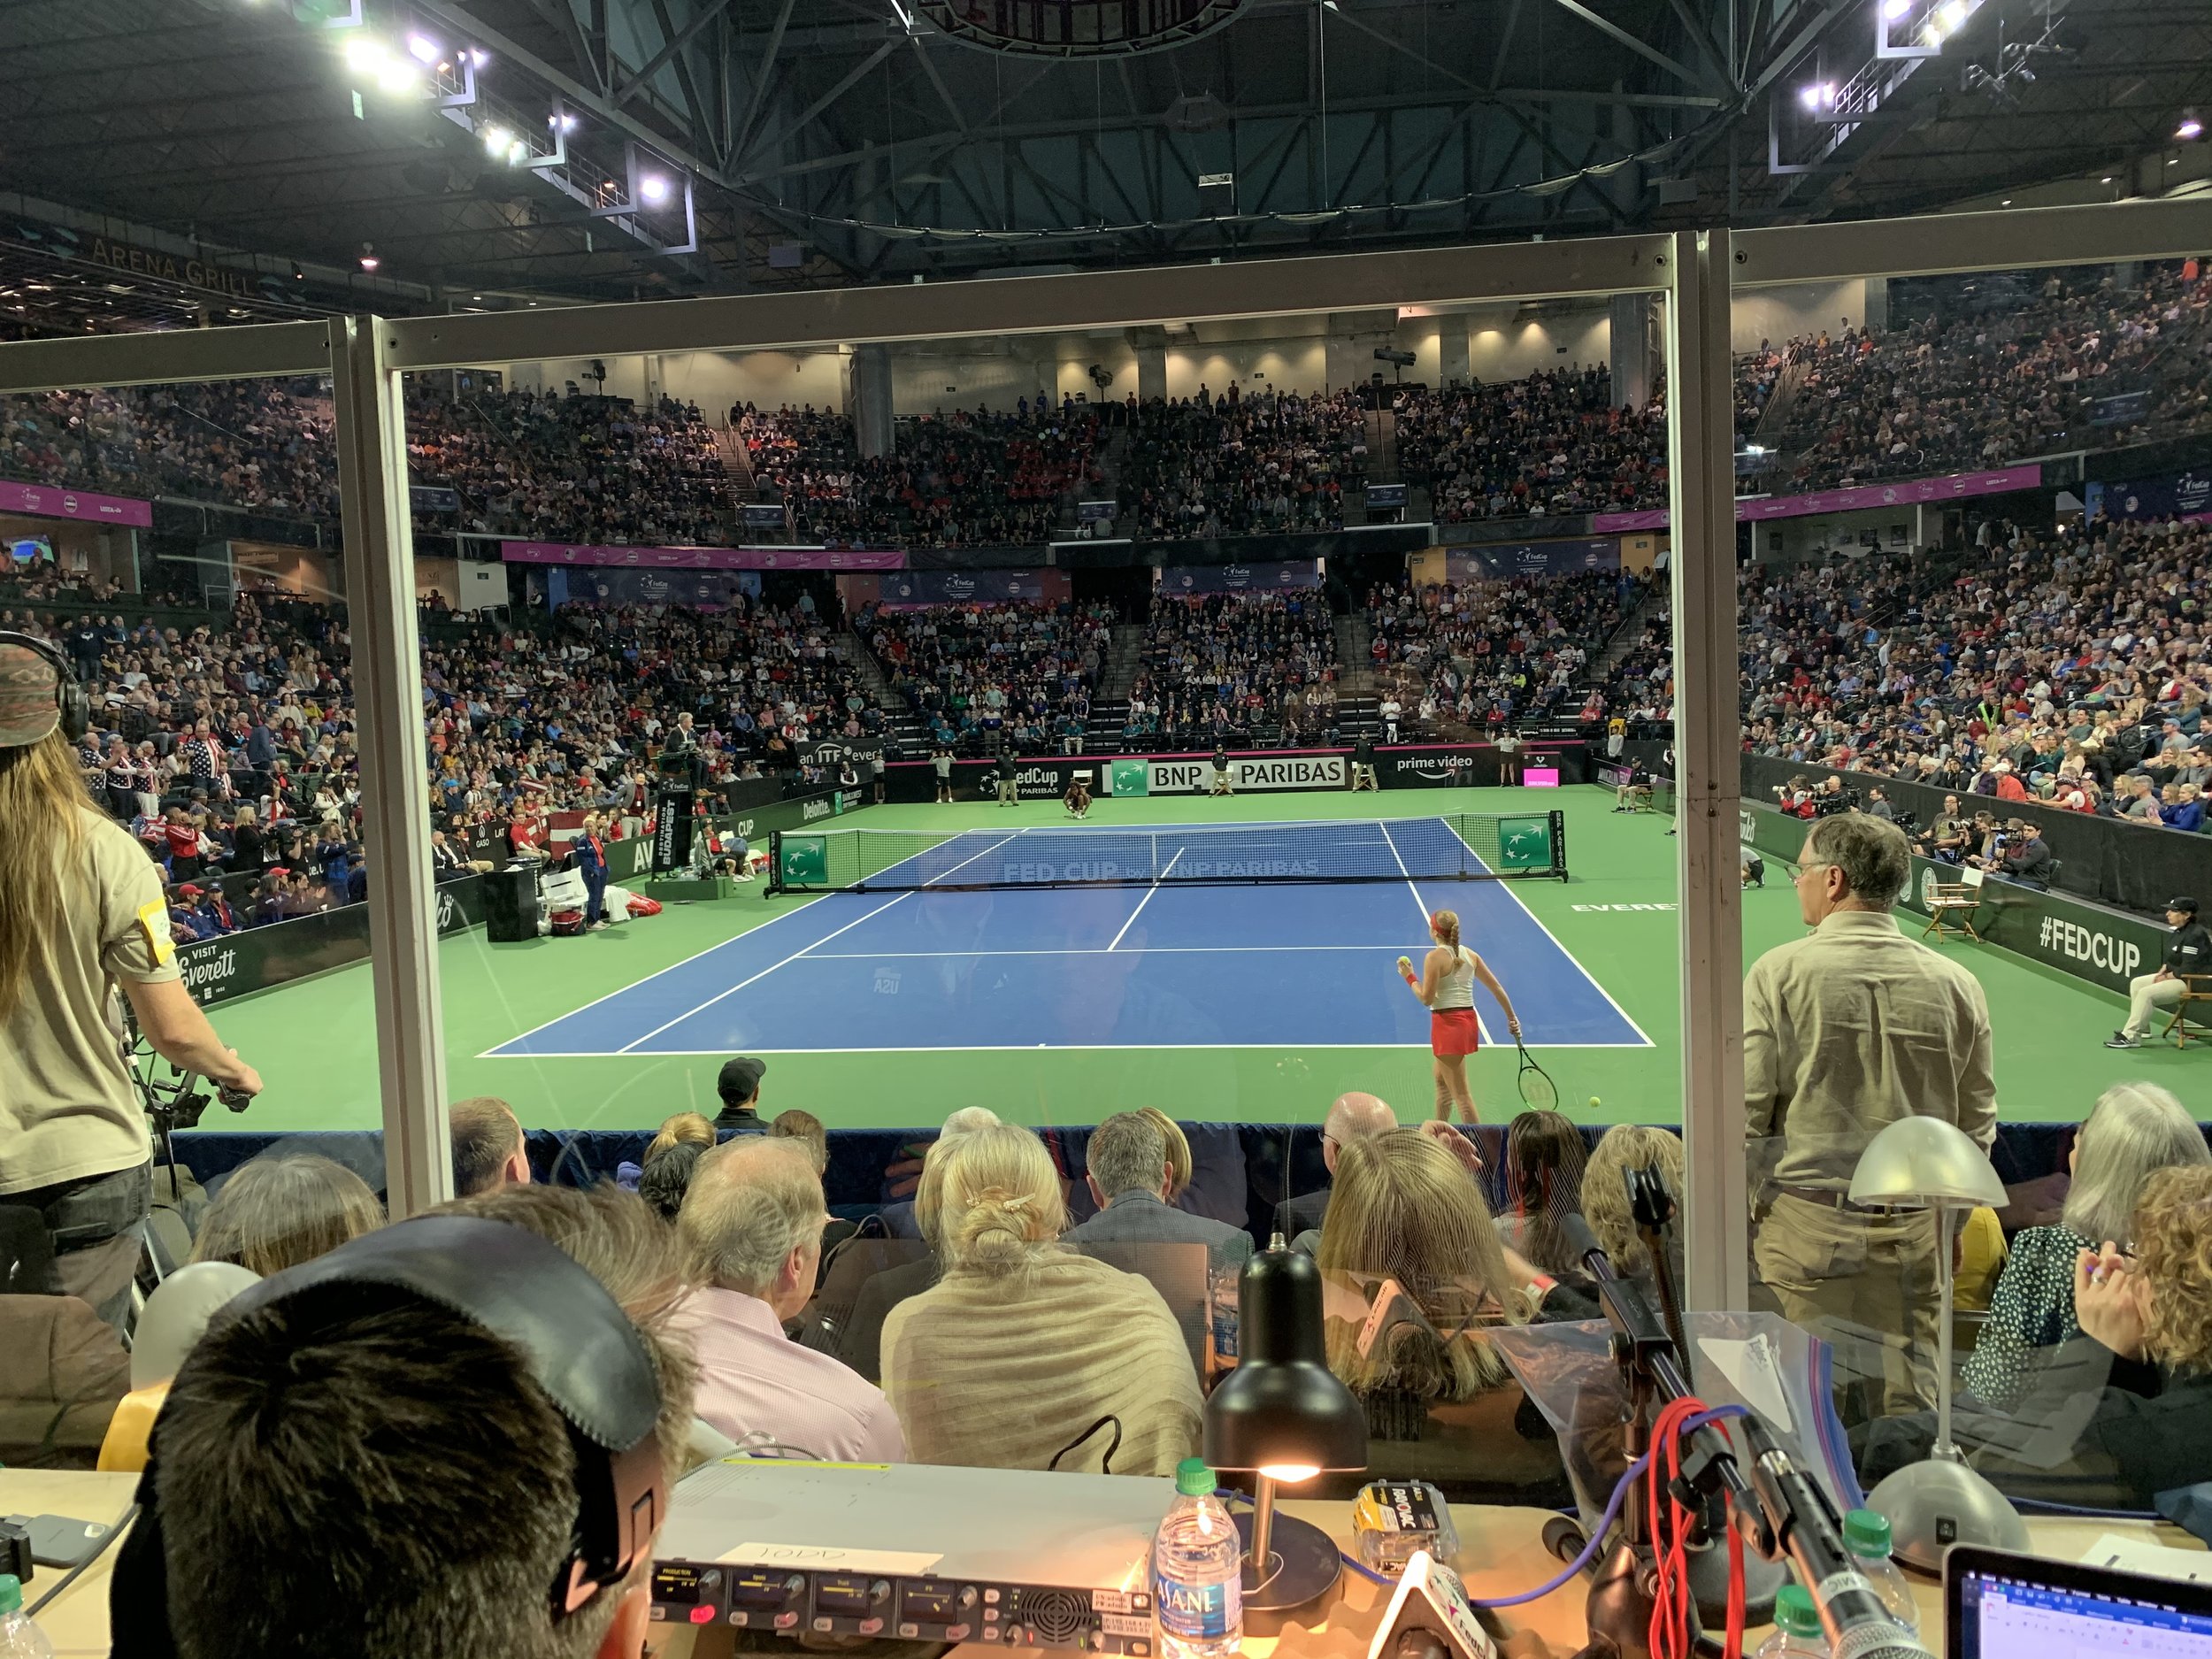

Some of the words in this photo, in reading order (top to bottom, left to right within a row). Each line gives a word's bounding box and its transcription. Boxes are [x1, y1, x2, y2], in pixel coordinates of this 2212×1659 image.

[92, 238, 177, 280] ARENA
[186, 260, 256, 296] GRILL
[800, 755, 813, 764] an
[818, 749, 841, 763] ITF
[1397, 757, 1435, 772] prime
[1439, 756, 1473, 768] video
[1016, 767, 1058, 787] edCup
[1155, 766, 1202, 787] BNP
[1240, 761, 1341, 784] PARIBAS
[663, 799, 675, 865] BUDAPEST
[738, 818, 754, 837] CUP
[1003, 864, 1055, 882] FED
[1064, 862, 1118, 881] CUP
[1217, 859, 1319, 877] PARIBAS
[192, 945, 217, 960] VISIT
[2039, 915, 2140, 978] #FEDCUP
[179, 949, 236, 991] Everett
[1392, 1488, 1417, 1529] RAYOVAC
[1459, 1618, 1486, 1659] FedC
